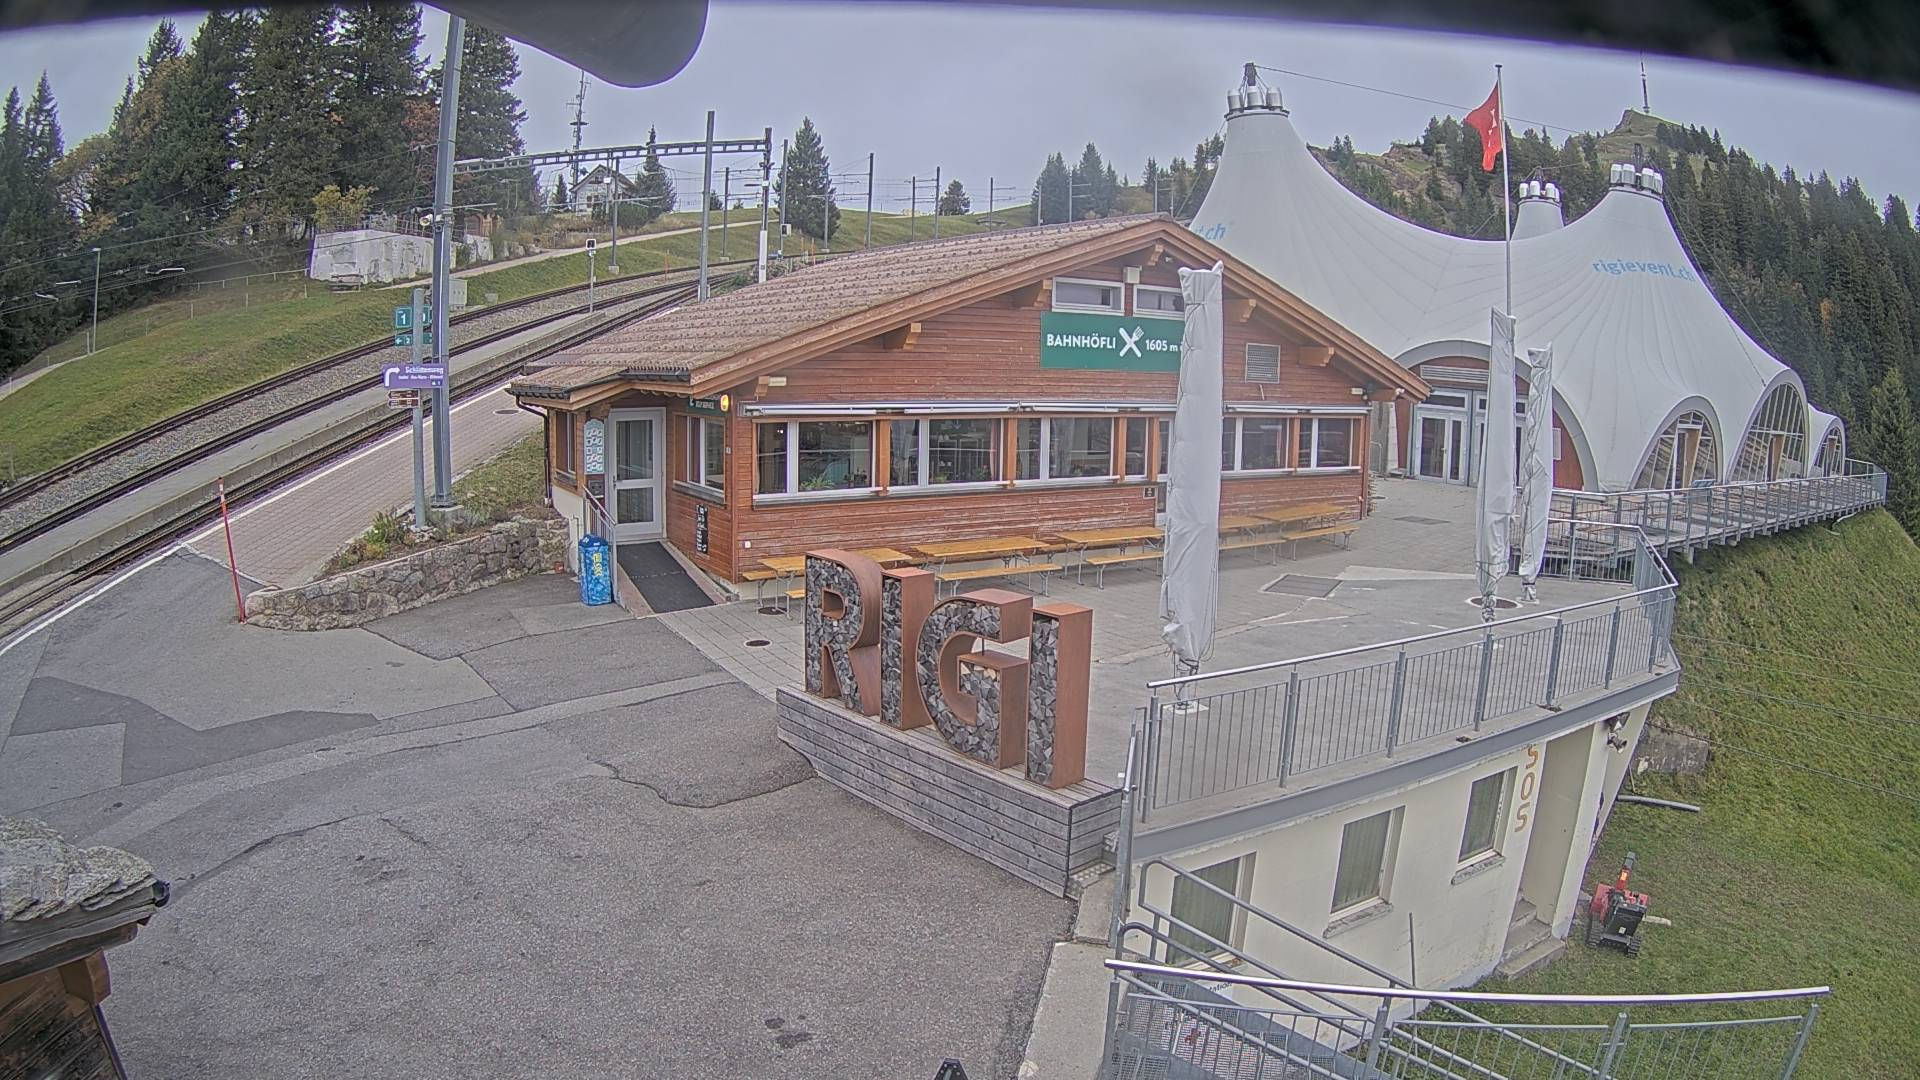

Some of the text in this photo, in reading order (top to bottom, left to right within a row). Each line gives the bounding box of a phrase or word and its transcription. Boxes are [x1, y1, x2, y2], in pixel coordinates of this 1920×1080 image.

[400, 313, 406, 325] 1
[1046, 333, 1116, 349] BAHNHÖFLI
[1145, 339, 1168, 352] 1605
[1169, 344, 1178, 352] m
[805, 549, 1093, 790] RIGI
[1514, 745, 1539, 833] SOS
